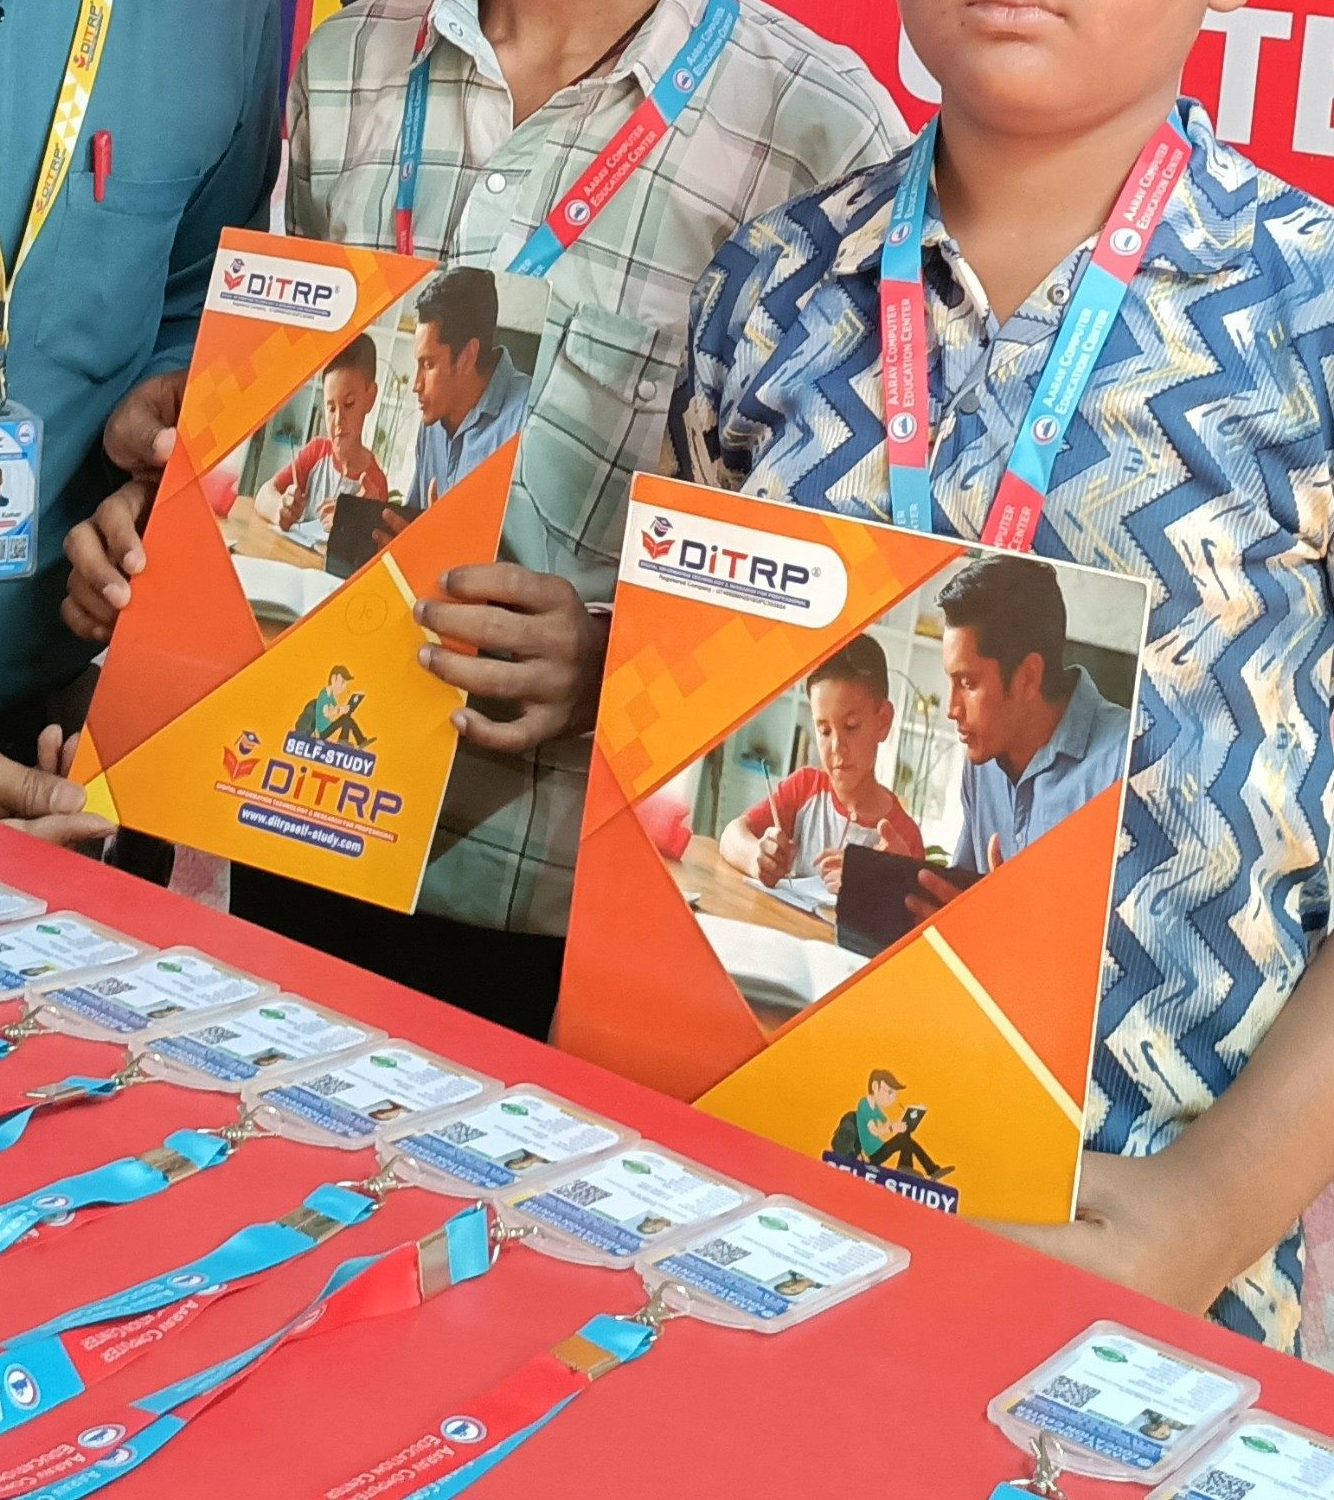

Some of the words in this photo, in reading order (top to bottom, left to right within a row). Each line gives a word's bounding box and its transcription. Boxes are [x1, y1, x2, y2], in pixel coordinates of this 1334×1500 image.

[589, 158, 631, 206] EDUCATION
[627, 129, 659, 162] CENTER
[606, 124, 646, 168] COMPUTER
[1123, 192, 1144, 223] AARAV
[1138, 142, 1169, 191] COMPUTER
[1135, 183, 1165, 229] EDUCATION
[1159, 147, 1184, 182] CENTER
[885, 305, 898, 362] COMPUTER
[901, 299, 912, 345] CENTER
[887, 366, 898, 404] AARAV
[902, 349, 915, 406] EDUCATION
[1041, 368, 1066, 406] AARAV
[1061, 307, 1094, 369] COMPUTER
[1054, 363, 1086, 415] EDUCATION
[1079, 308, 1111, 362] CENTER
[285, 738, 373, 775] SELF-STUDY
